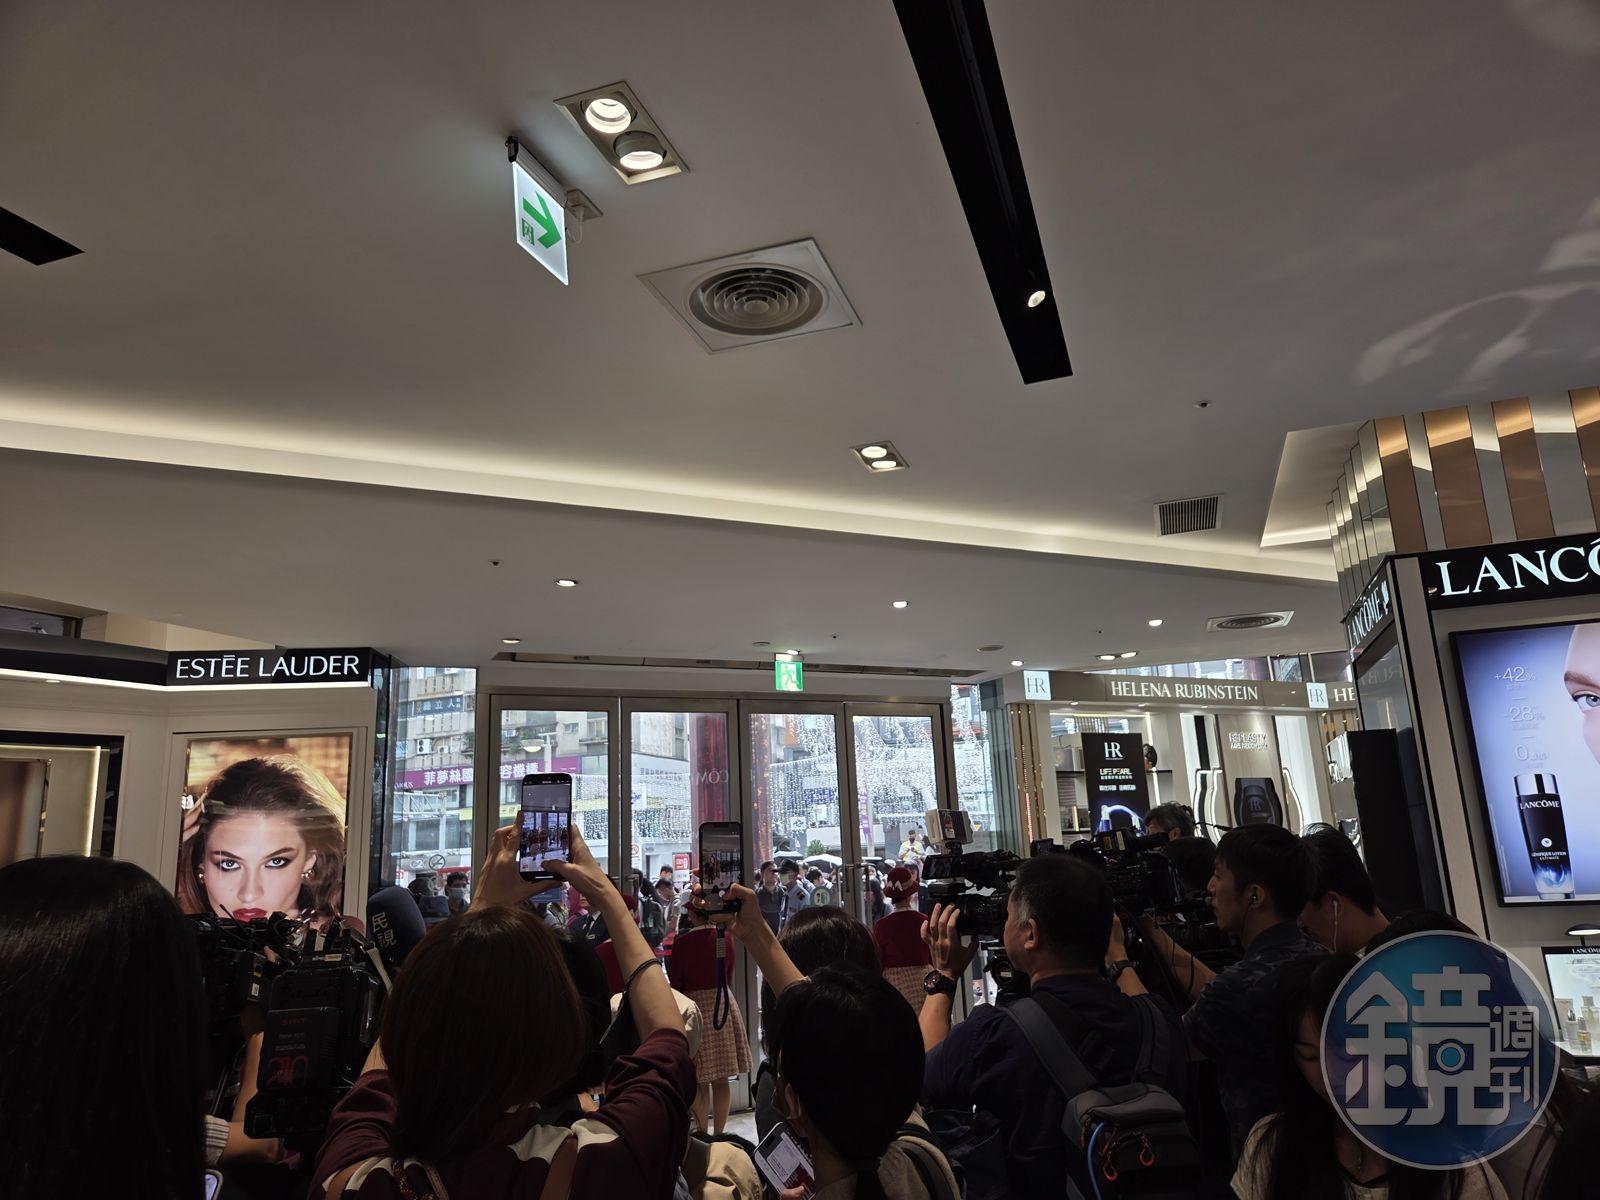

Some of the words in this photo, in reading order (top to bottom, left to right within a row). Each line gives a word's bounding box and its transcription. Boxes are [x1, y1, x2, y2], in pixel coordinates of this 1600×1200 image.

[1347, 586, 1384, 650] LANCÔME
[259, 655, 360, 678] LAUDER
[1026, 677, 1046, 694] HR
[1111, 681, 1170, 698] HELENA
[1175, 683, 1259, 701] RUBINSTEIN
[1309, 688, 1326, 703] HR
[1104, 742, 1123, 758] HR
[1520, 800, 1560, 809] LANCÔME
[372, 912, 397, 948] 民視
